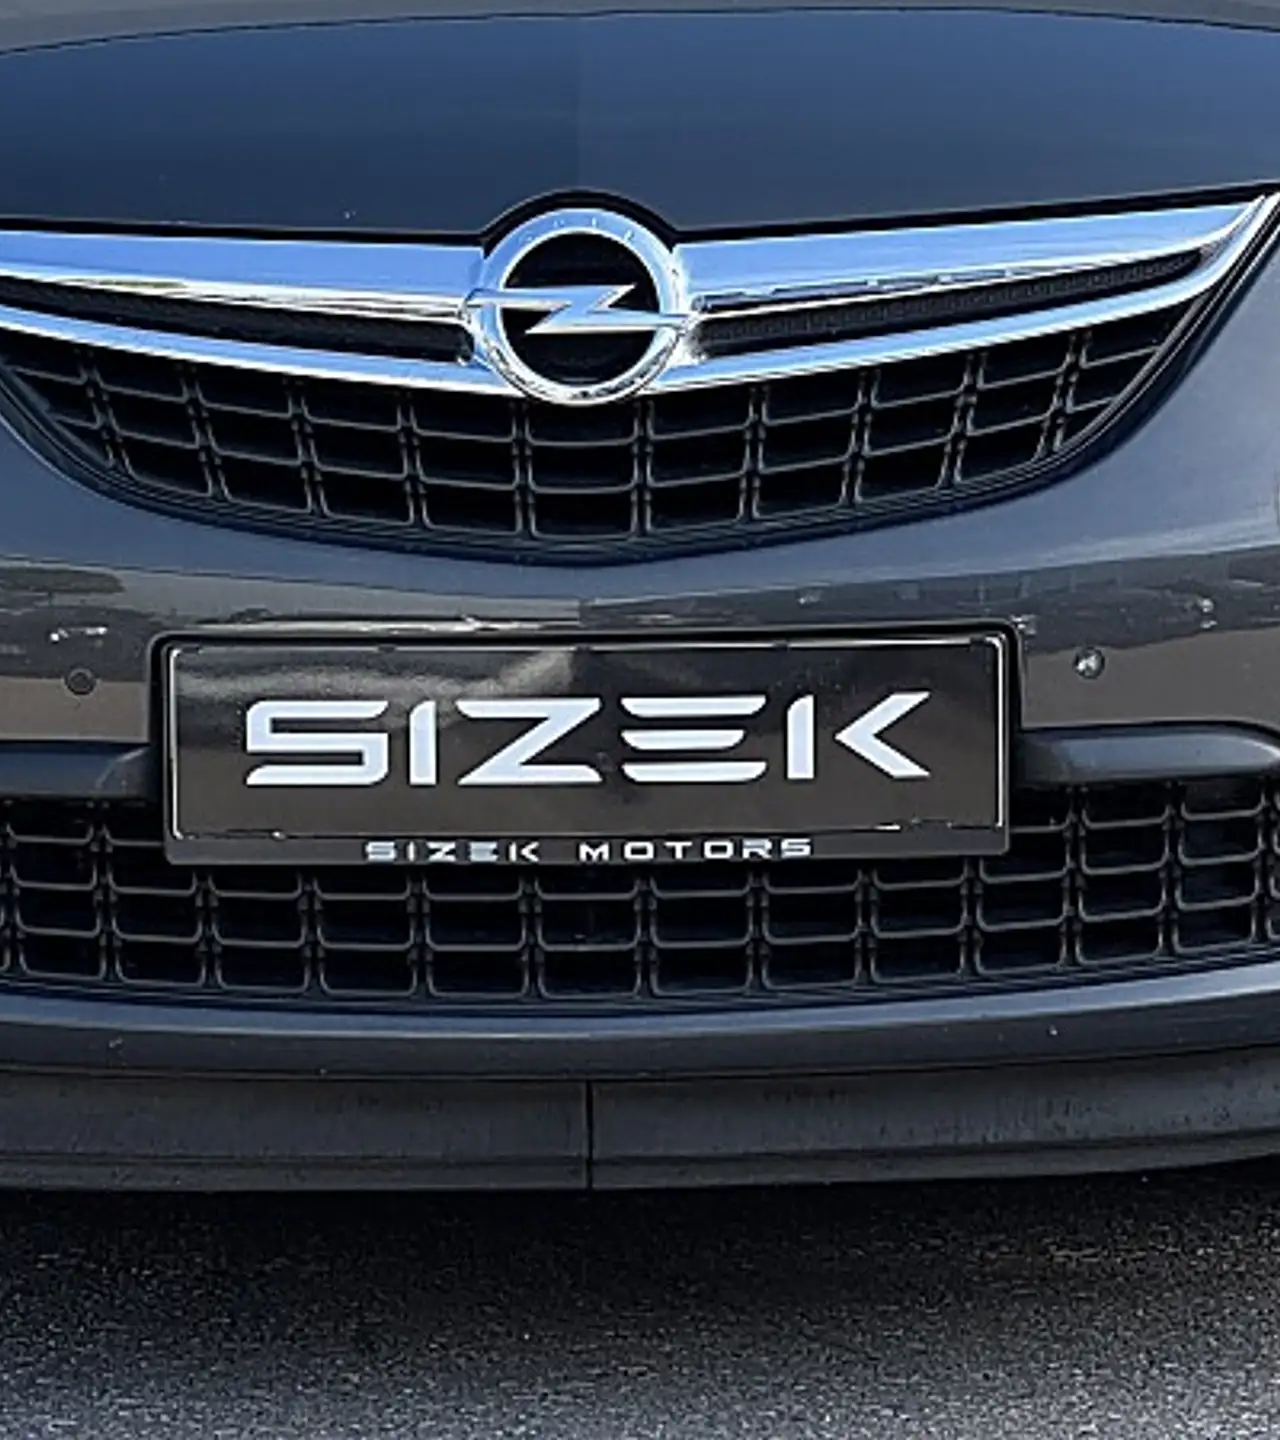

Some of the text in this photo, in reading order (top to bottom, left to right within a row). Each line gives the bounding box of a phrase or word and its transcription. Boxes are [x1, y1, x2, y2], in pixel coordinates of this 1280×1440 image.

[246, 691, 930, 785] SIZEK
[365, 838, 811, 863] SIZEK MOTORS
